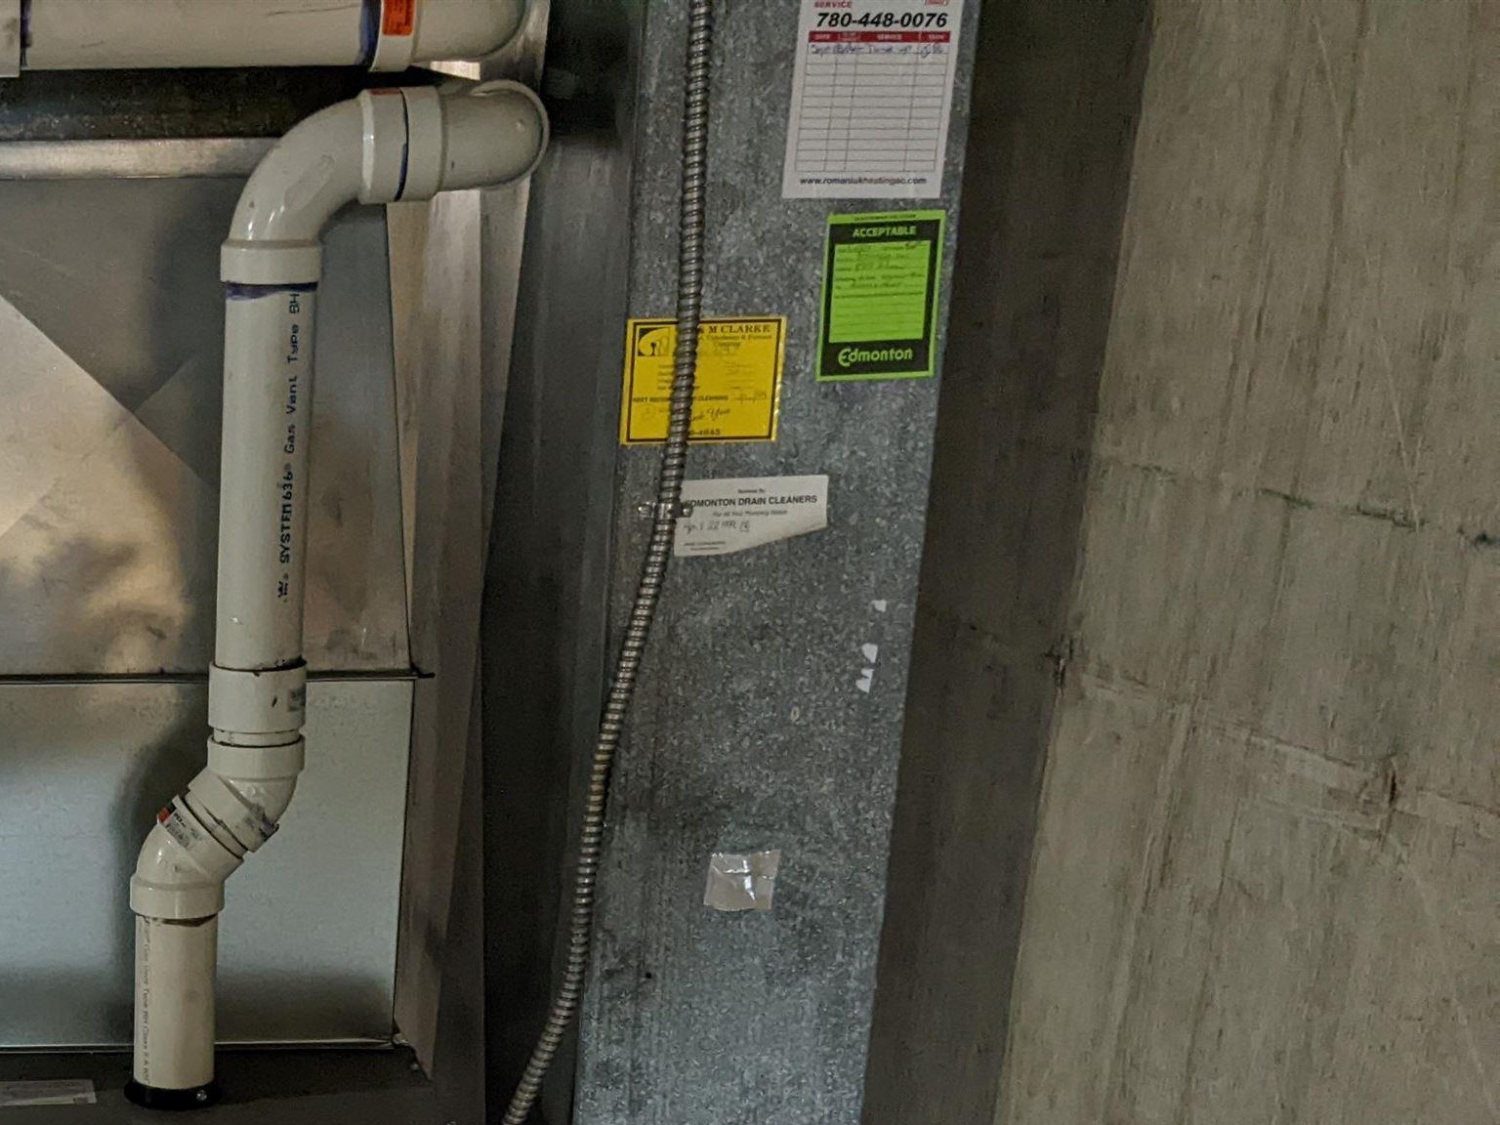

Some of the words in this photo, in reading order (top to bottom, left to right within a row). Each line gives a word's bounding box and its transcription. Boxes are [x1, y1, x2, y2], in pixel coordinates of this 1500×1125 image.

[816, 12, 948, 28] 780-448-0076
[852, 225, 917, 238] ACCEPTABLE
[720, 324, 772, 334] CLARKE
[287, 324, 299, 365] Type
[838, 347, 915, 367] Edmonton
[286, 375, 298, 415] Vent
[284, 423, 296, 455] Gas
[738, 497, 767, 506] DRAIN
[768, 495, 818, 505] CLEANERS
